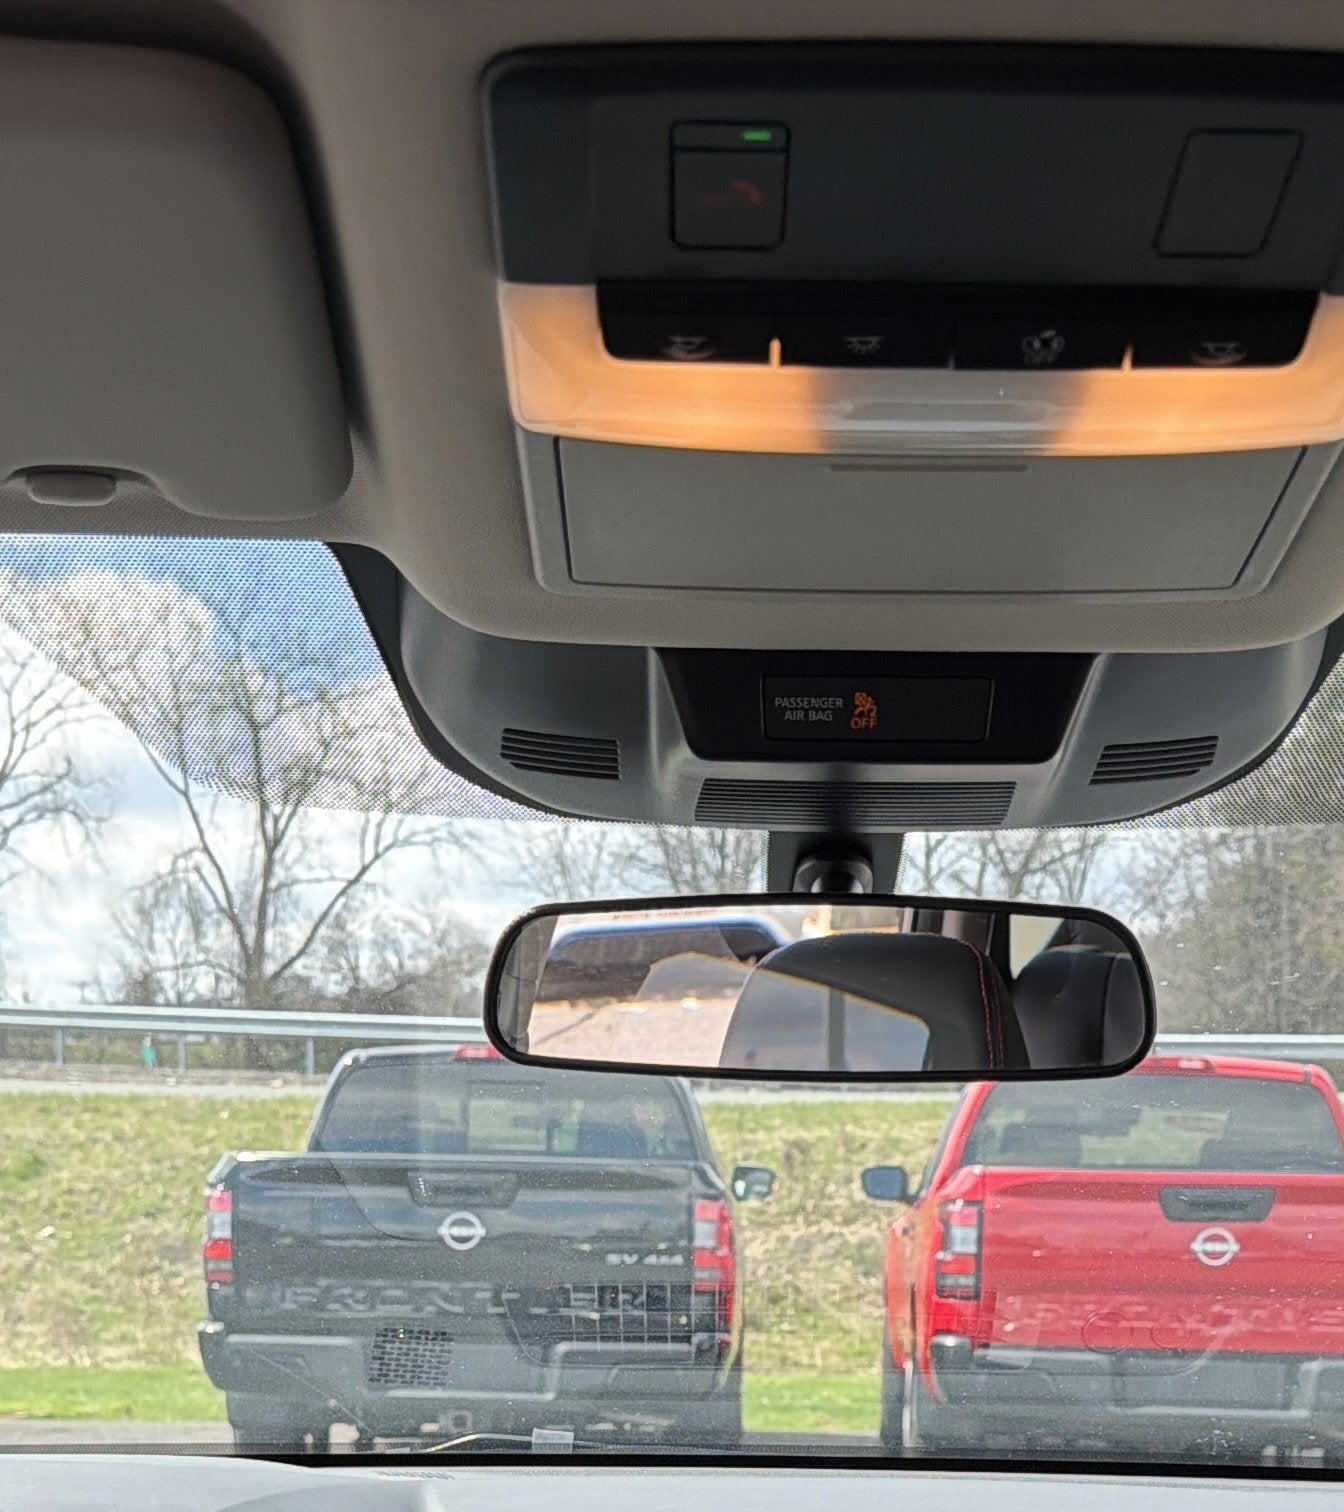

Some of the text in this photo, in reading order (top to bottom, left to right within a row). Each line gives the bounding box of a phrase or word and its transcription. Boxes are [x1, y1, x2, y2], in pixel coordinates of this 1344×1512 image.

[774, 696, 845, 709] PASSENGER
[783, 710, 834, 722] AIR BAG
[850, 718, 878, 730] OFF
